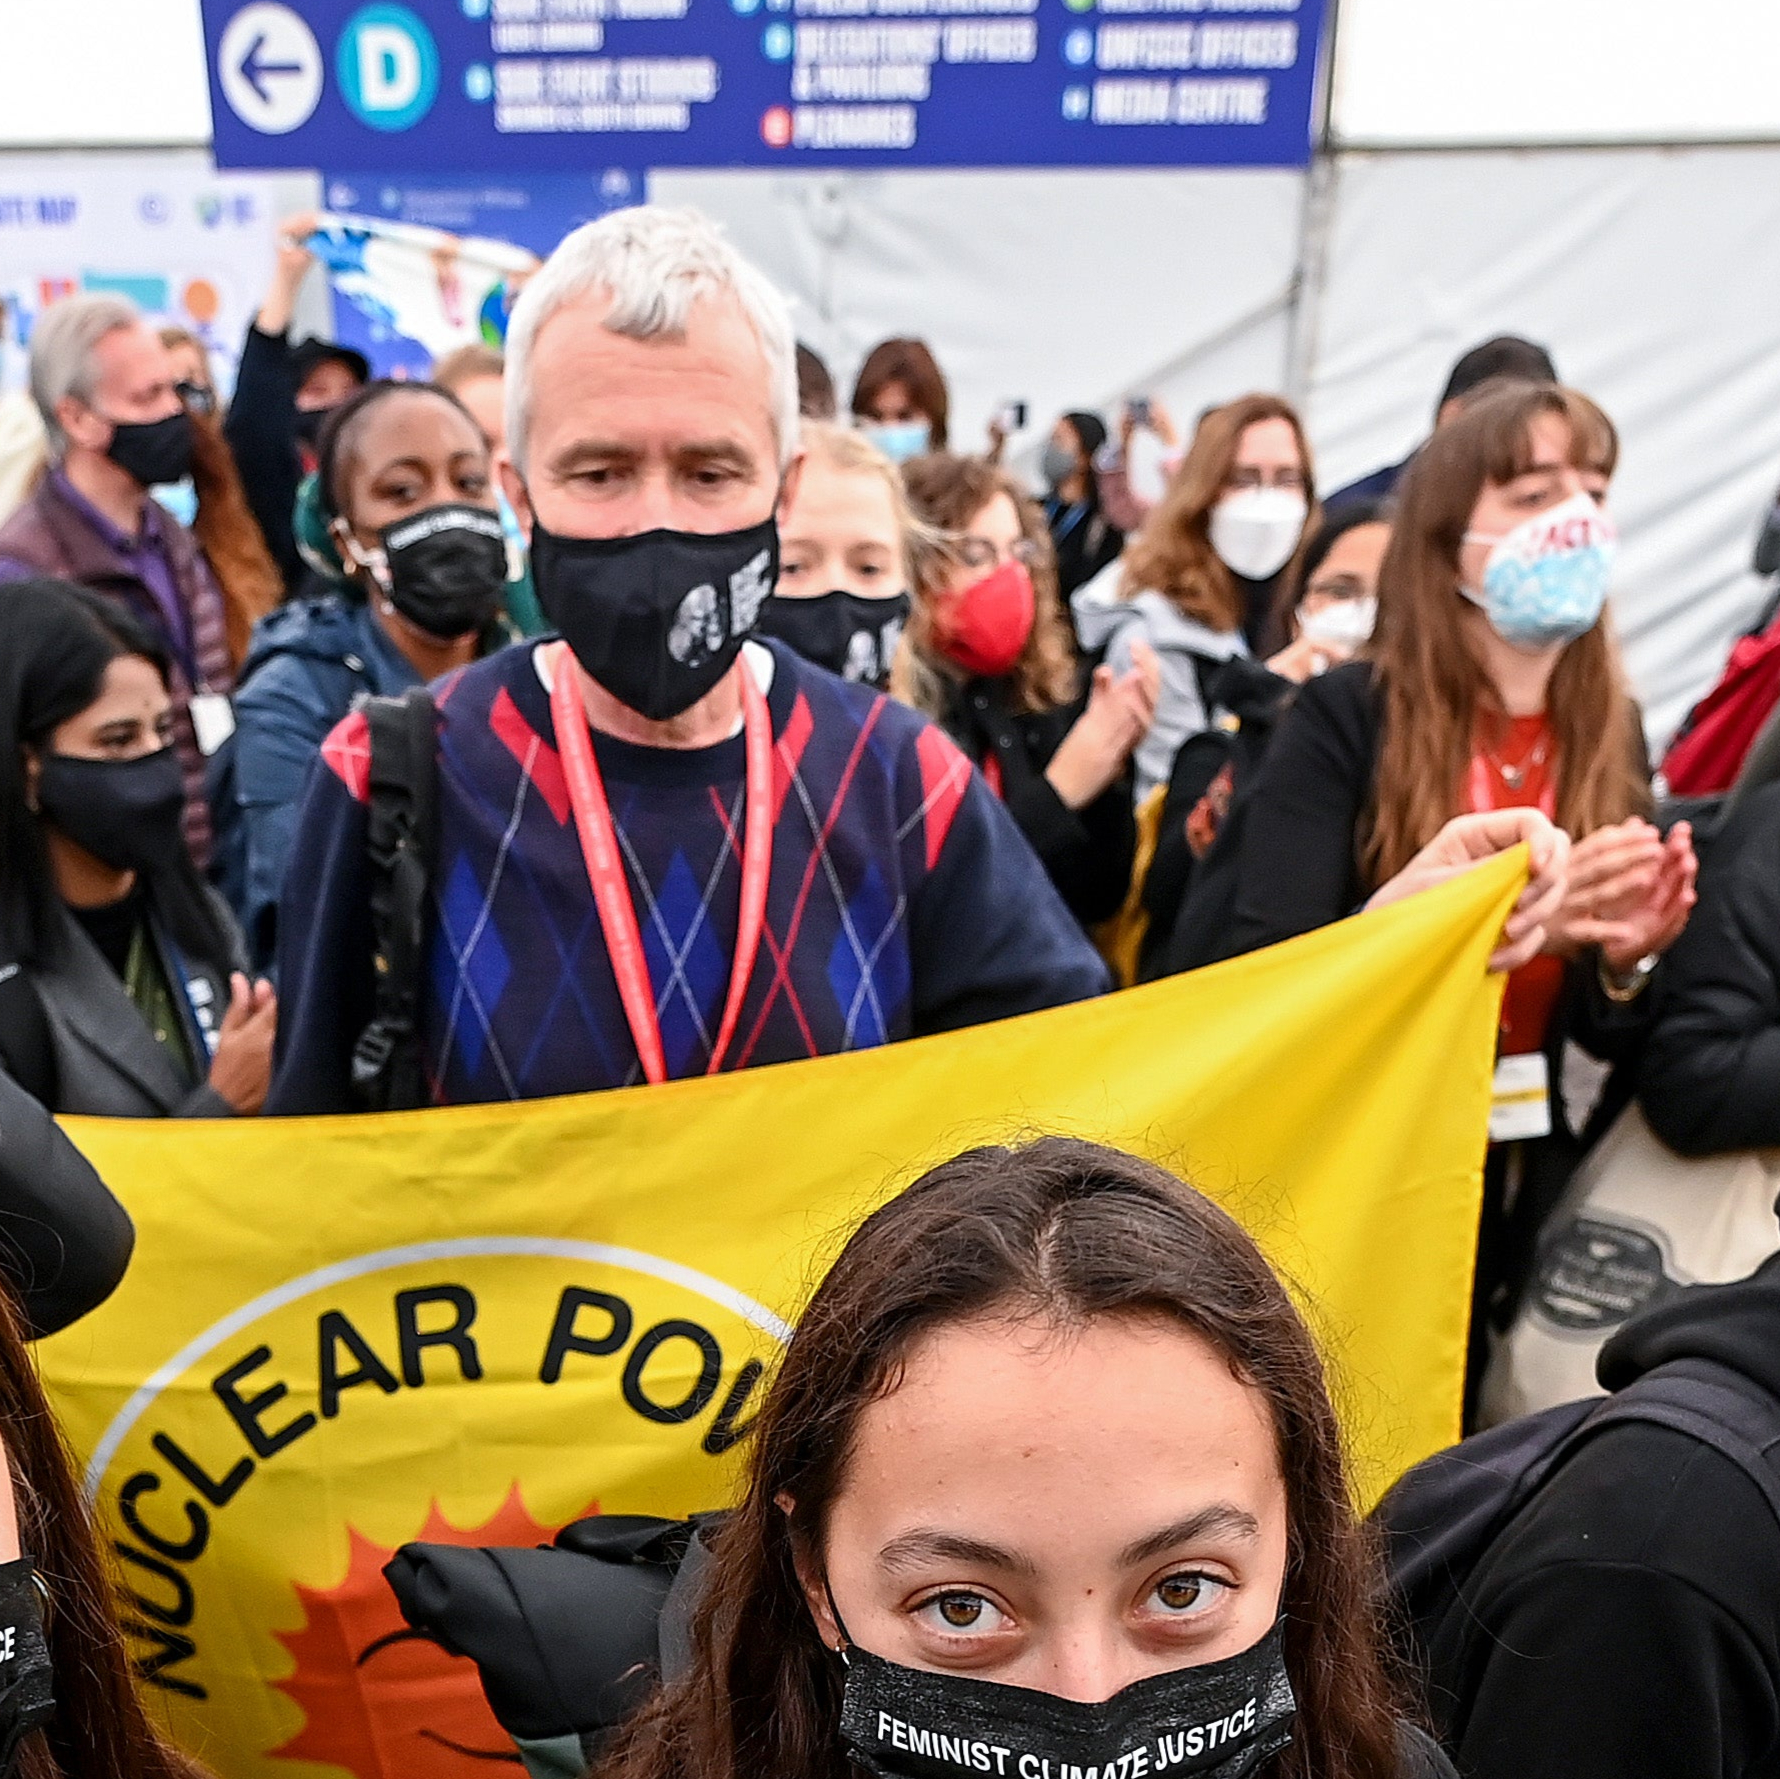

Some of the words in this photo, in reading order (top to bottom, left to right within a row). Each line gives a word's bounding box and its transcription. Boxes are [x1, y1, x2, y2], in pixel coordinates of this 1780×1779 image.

[354, 24, 423, 111] D
[112, 1282, 485, 1702] NUCLEAR
[539, 1284, 767, 1455] PO
[877, 1710, 1011, 1777] FEMINIST
[1154, 1697, 1258, 1772] JUSTICE
